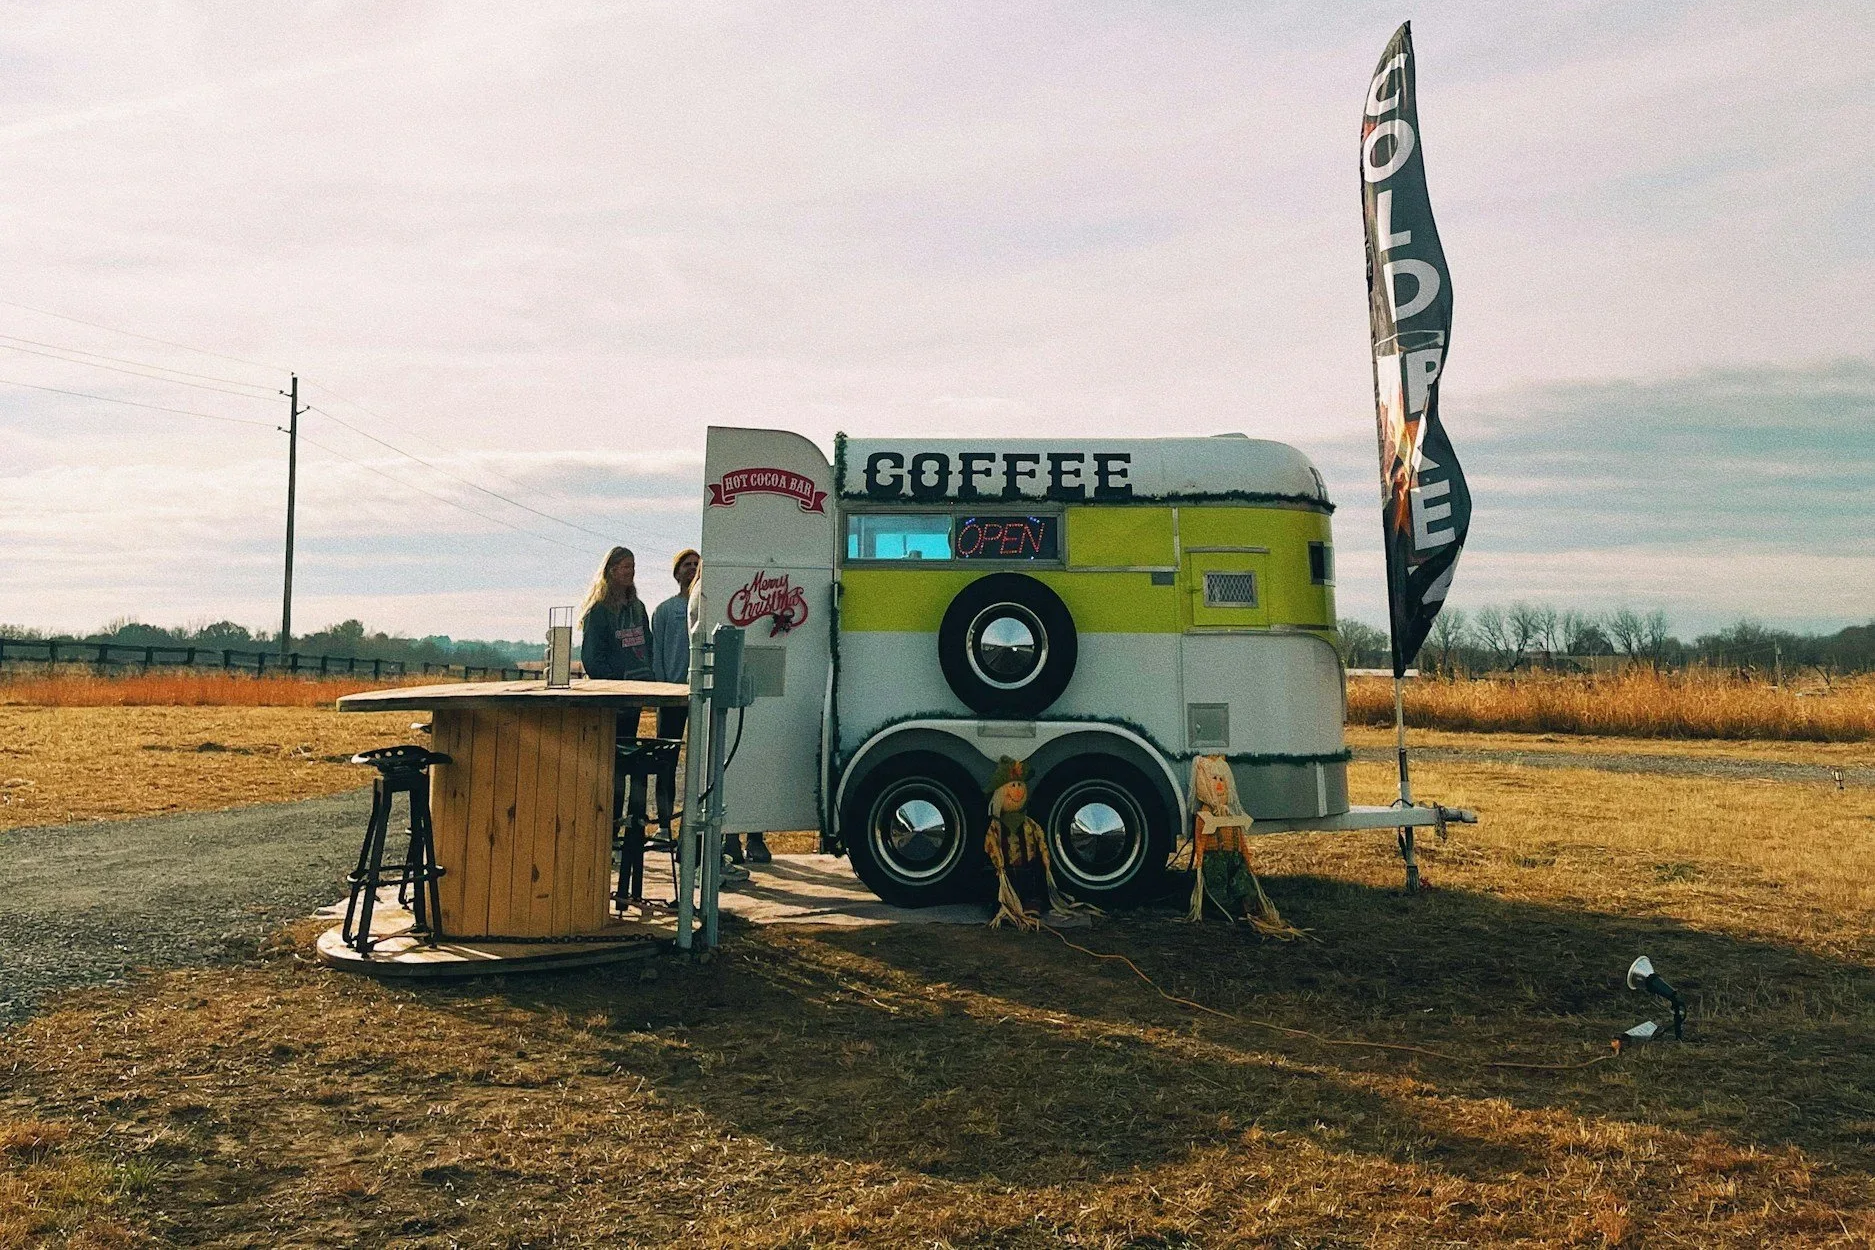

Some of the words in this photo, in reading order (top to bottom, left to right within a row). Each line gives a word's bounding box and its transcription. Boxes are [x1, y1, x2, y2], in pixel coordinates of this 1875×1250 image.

[1363, 52, 1442, 323] COLD
[724, 473, 748, 491] HOT
[749, 472, 787, 489] COCOA
[788, 477, 812, 497] BAR
[863, 452, 1132, 500] COFFEE
[957, 522, 1046, 555] OPEN
[750, 570, 789, 600] Merry
[727, 584, 809, 627] Christmas
